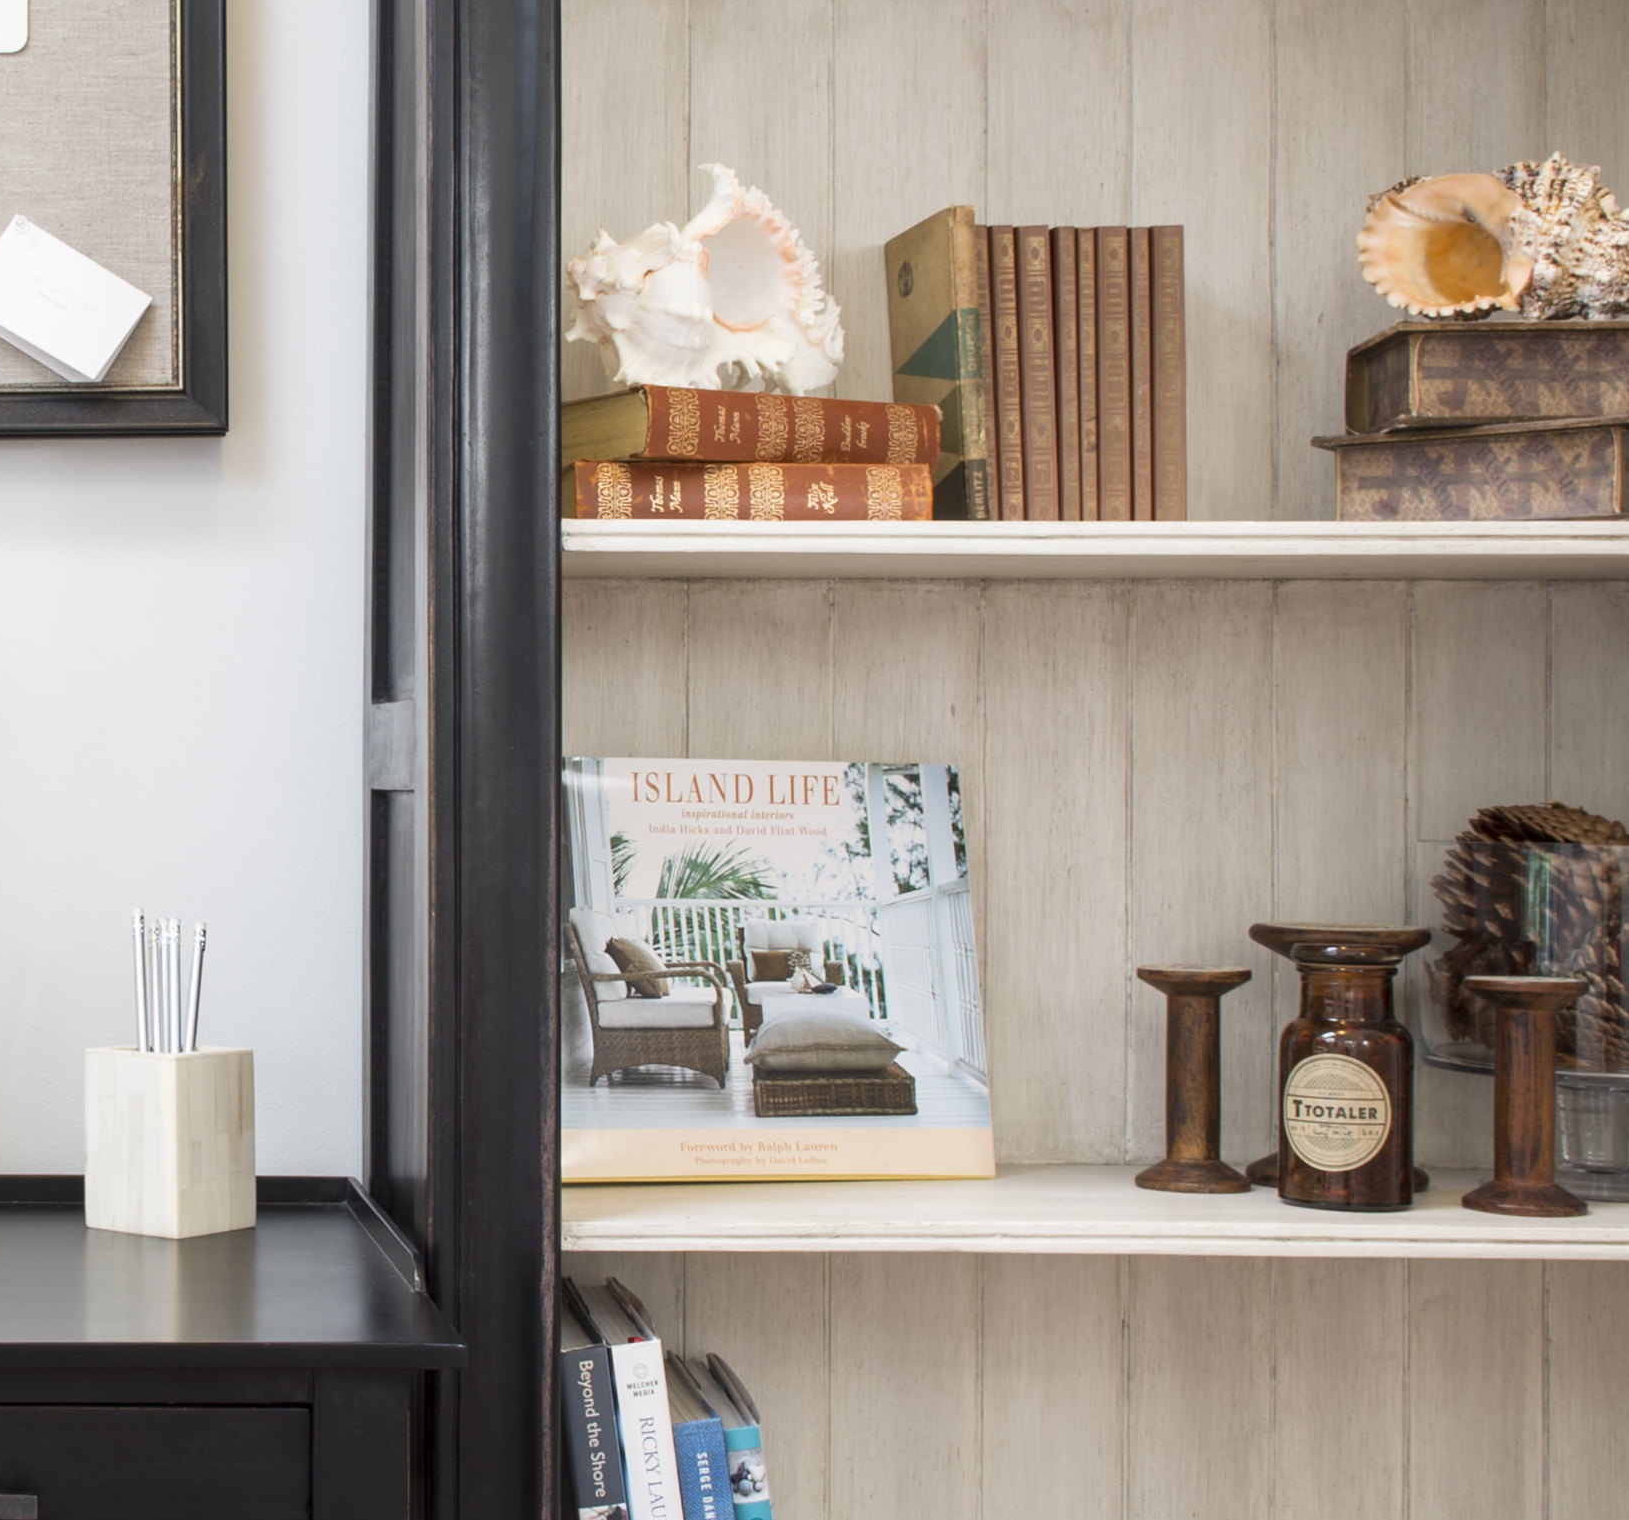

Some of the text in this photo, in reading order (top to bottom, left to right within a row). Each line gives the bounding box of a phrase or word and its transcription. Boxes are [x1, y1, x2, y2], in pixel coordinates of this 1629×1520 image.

[713, 405, 727, 443] Thomas
[651, 475, 665, 513] Thomas
[670, 480, 683, 513] Mann
[807, 482, 822, 511] Felix
[973, 471, 987, 519] BERLITZ
[631, 771, 841, 806] ISLAND LIFE
[648, 823, 828, 837] India Hicks and David Flint Wood
[681, 807, 795, 821] inspirational interiors
[679, 1141, 838, 1155] Foreword by Ralph Lauren
[694, 1155, 828, 1168] Photography by David Loftus
[627, 1380, 659, 1391] MELCHER
[633, 1389, 655, 1398] MEDIA
[579, 1359, 607, 1498] Beyond the Shore
[639, 1416, 661, 1475] RICKY
[697, 1451, 712, 1492] SERGE
